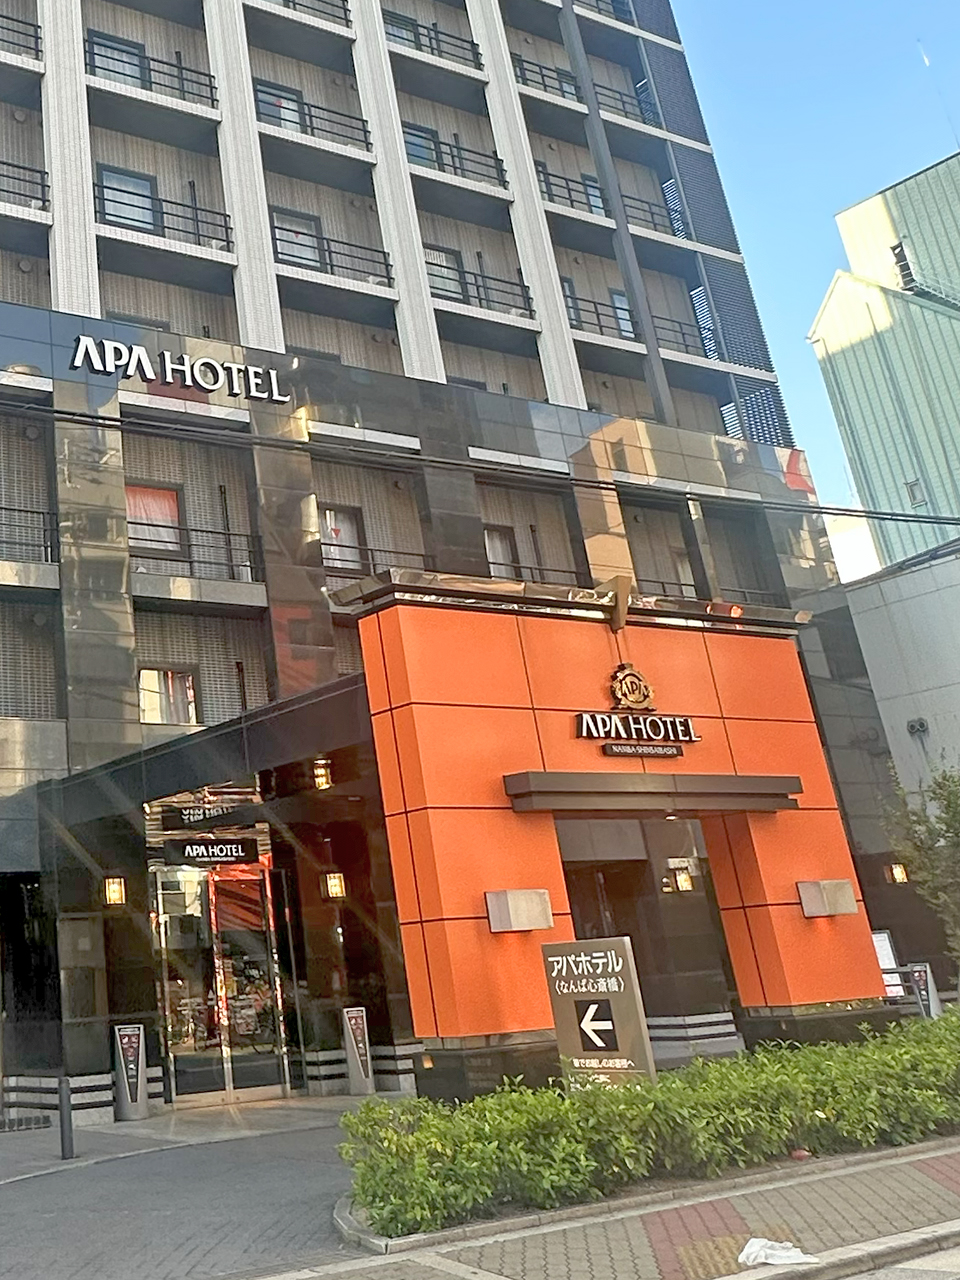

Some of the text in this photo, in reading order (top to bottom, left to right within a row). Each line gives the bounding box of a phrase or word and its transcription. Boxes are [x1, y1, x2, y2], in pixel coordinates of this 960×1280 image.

[72, 334, 291, 402] APA HOTEL
[581, 713, 702, 741] APA HOTEL
[184, 844, 246, 857] APA HOTEL
[547, 949, 623, 978] アパホテル
